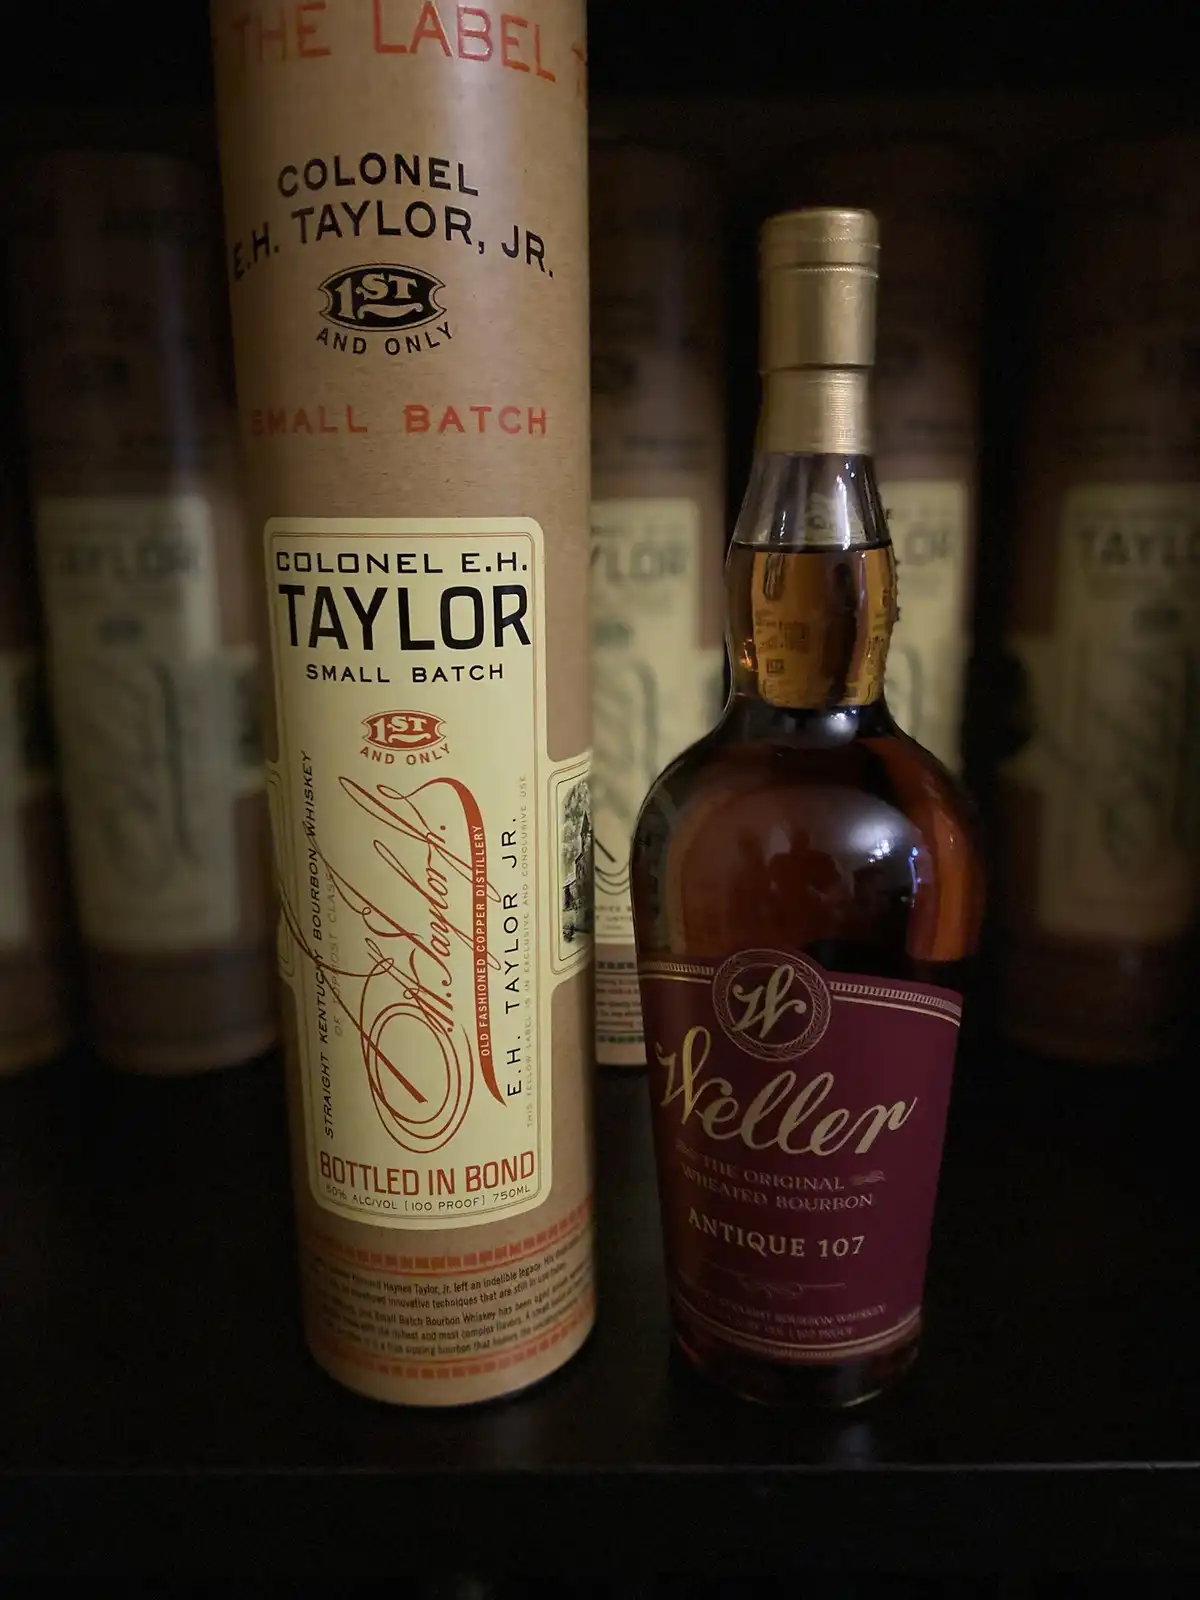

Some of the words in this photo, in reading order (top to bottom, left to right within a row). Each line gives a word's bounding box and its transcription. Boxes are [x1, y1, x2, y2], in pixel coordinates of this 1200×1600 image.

[232, 0, 331, 62] THE
[373, 0, 555, 82] LABEL
[278, 152, 479, 197] COLONEL
[233, 222, 279, 281] E.H.
[291, 201, 485, 255] TAYLOR,
[502, 225, 554, 278] JR.
[334, 272, 419, 320] 1ST
[315, 327, 367, 355] AND
[385, 321, 453, 355] ONLY
[250, 404, 368, 436] SMALL
[404, 404, 546, 435] BATCH
[276, 551, 443, 574] COLONEL
[462, 551, 528, 573] E.H.
[279, 584, 531, 650] TAYLOR
[306, 663, 390, 683] SMALL
[412, 663, 504, 683] BATCH
[374, 715, 428, 744] 1ST
[360, 745, 395, 766] AND
[406, 743, 450, 766] ONLY
[301, 750, 316, 837] WHISKEY
[519, 775, 527, 797] USE
[472, 825, 485, 897] DISTILLERY
[501, 818, 518, 869] JR.
[308, 848, 322, 941] BOURBON
[475, 903, 486, 953] COPPER
[522, 911, 530, 973] EXCLUSIVE
[502, 893, 520, 1015] TAYLOR
[312, 949, 328, 1044] KENTUCKY
[476, 959, 488, 1027] FASHIONED
[524, 998, 532, 1009] IS
[333, 1015, 343, 1037] OF
[481, 1033, 490, 1057] OLD
[524, 1017, 532, 1050] LABEL
[507, 1036, 522, 1097] E.H.
[525, 1056, 533, 1096] YELLOW
[321, 1052, 334, 1139] STRAIGHT
[654, 1025, 918, 1157] Weller
[526, 1103, 534, 1128] THIS
[320, 1151, 419, 1196] BOTTLED
[429, 1168, 455, 1196] IN
[466, 1150, 534, 1193] BOND
[680, 1162, 769, 1205] WHEATED
[775, 1193, 873, 1212] BOURBON
[702, 1154, 737, 1178] THE
[744, 1169, 845, 1190] ORIGINAL
[325, 1183, 348, 1200] 50%
[353, 1194, 398, 1211] ALC/VOL
[493, 1185, 531, 1202] 750ML
[688, 1206, 805, 1257] ANTIQUE
[818, 1235, 865, 1258] 107
[432, 1296, 478, 1309] techniques
[480, 1290, 497, 1304] that
[499, 1286, 512, 1299] are
[454, 1281, 468, 1293] left
[471, 1281, 481, 1290] an
[484, 1271, 517, 1288] indelible
[425, 1315, 460, 1327] Bourbon
[461, 1310, 496, 1325] Whiskey
[498, 1306, 512, 1316] has
